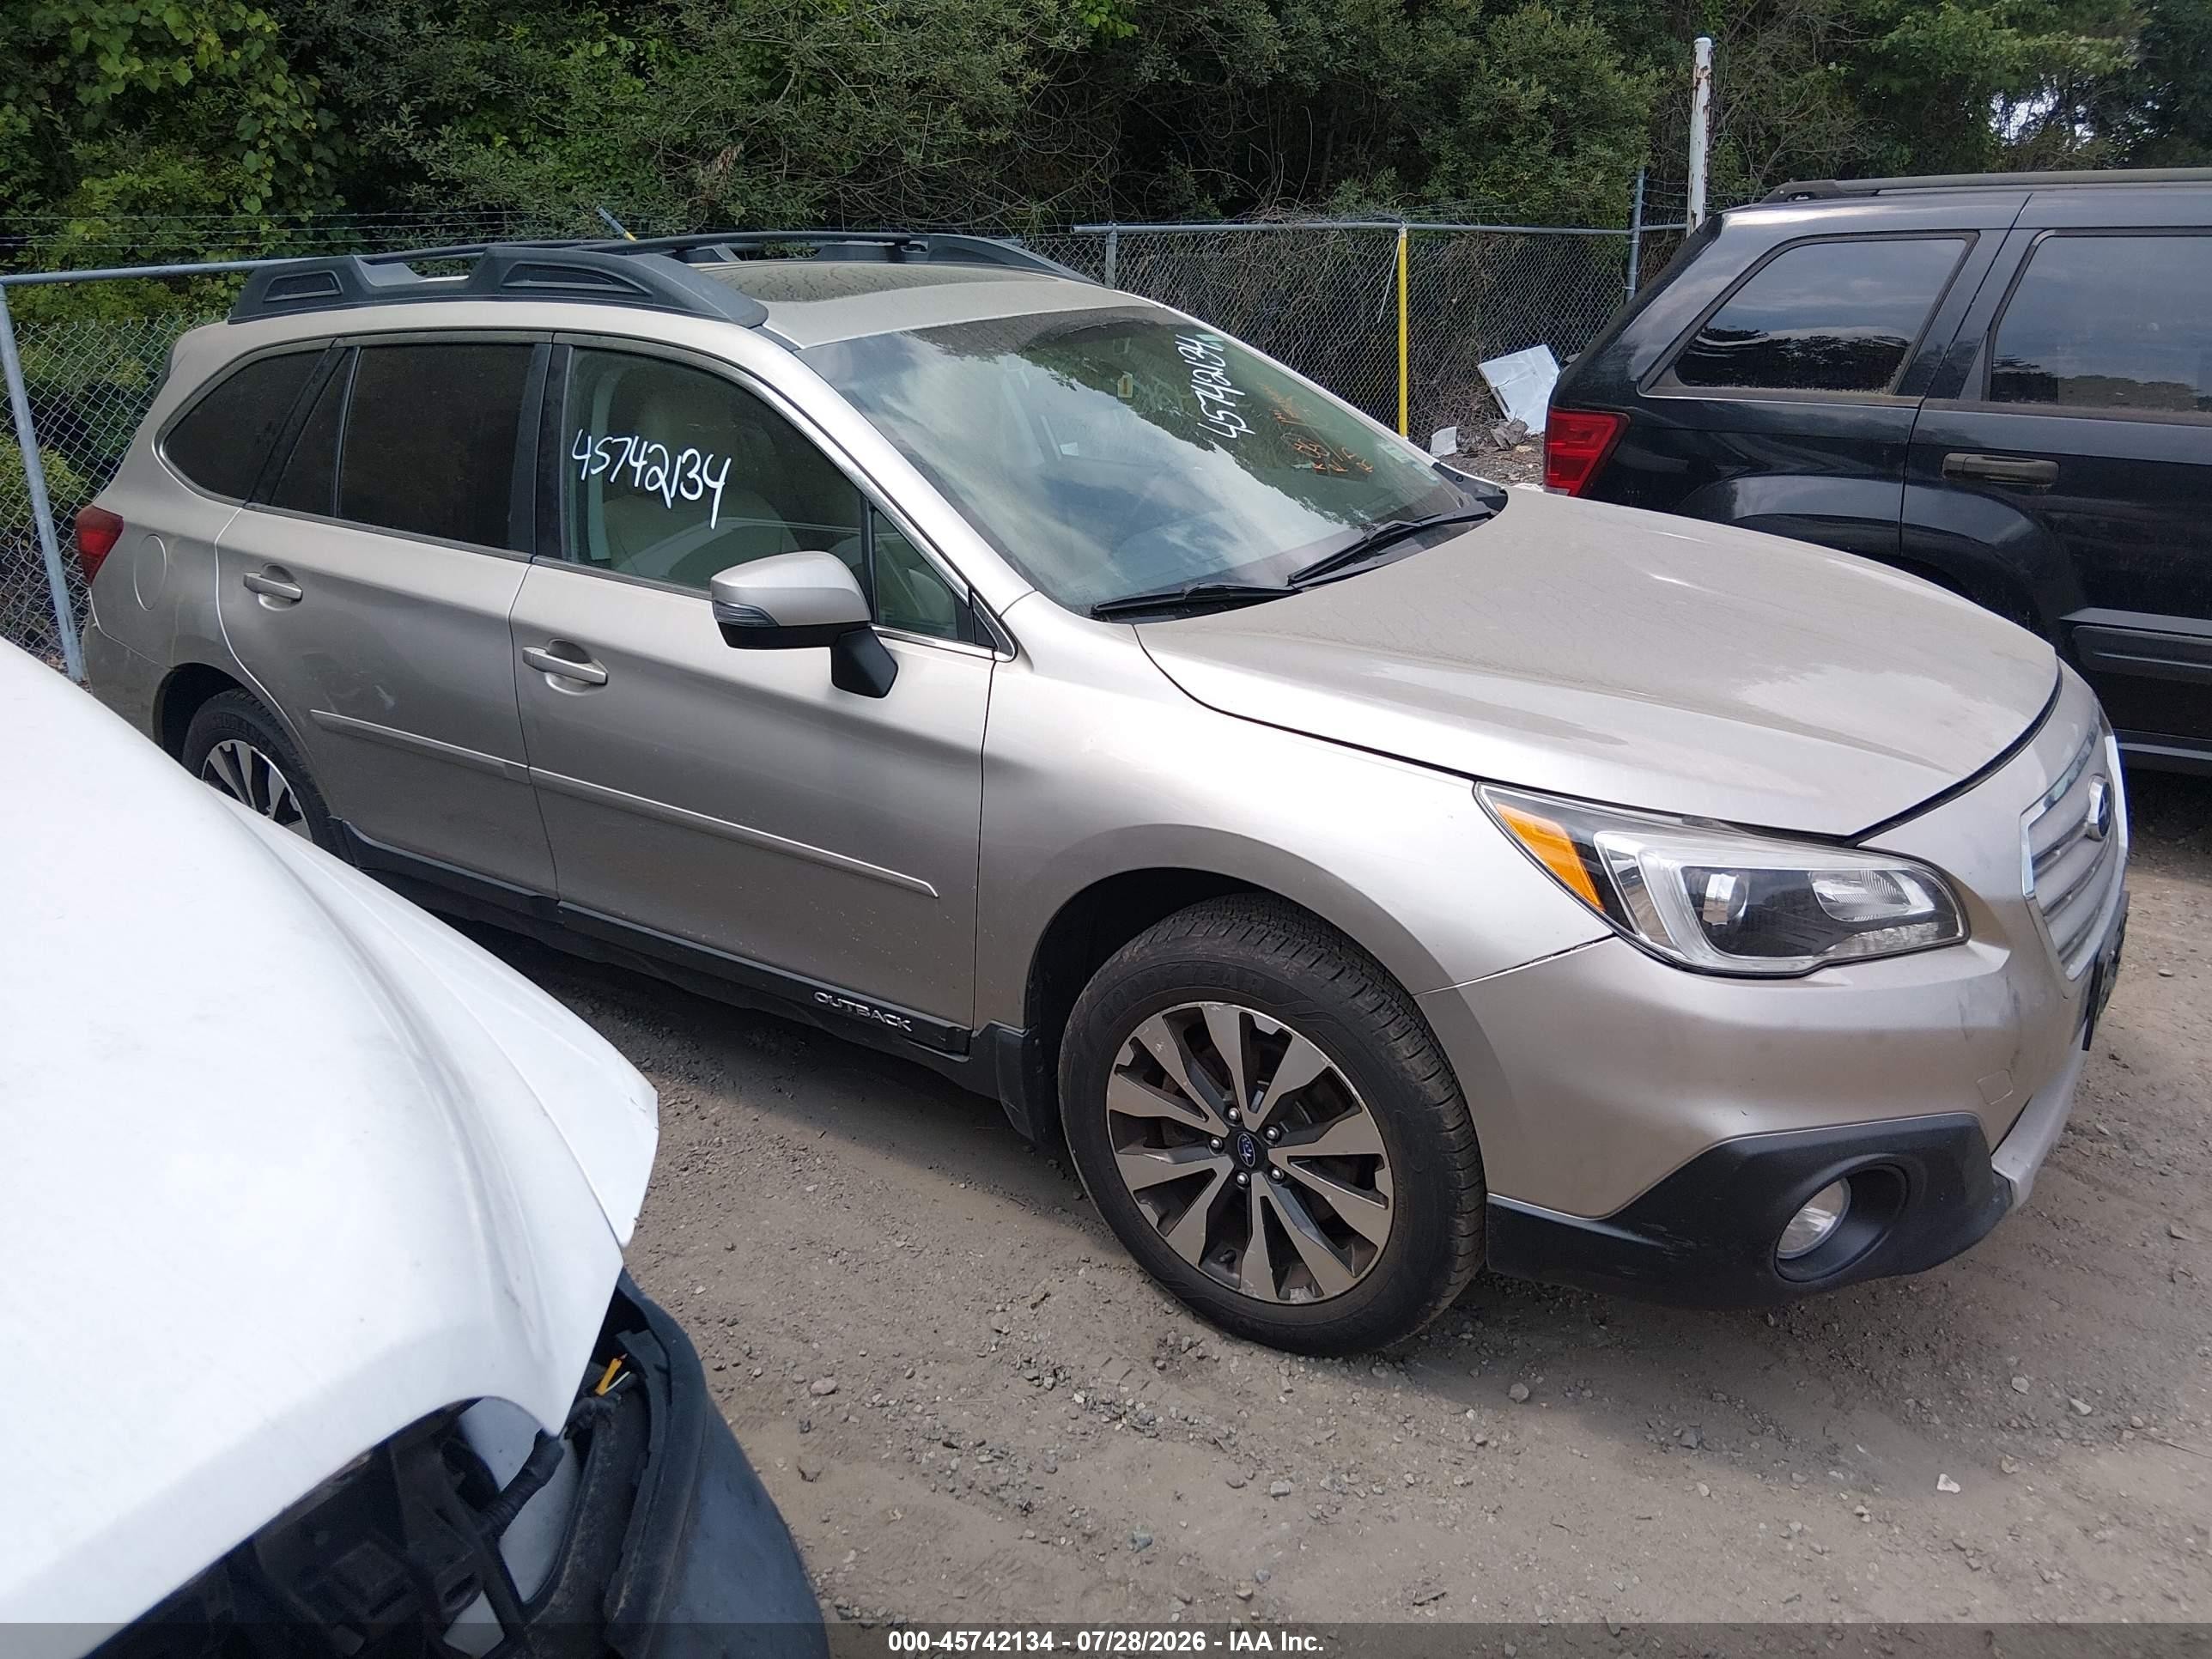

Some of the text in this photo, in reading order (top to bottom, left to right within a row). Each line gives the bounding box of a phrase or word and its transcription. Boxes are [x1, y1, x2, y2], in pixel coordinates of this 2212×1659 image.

[1175, 332, 1256, 440] 45742134
[572, 428, 732, 530] 45742134
[813, 991, 913, 1032] OUTBACK
